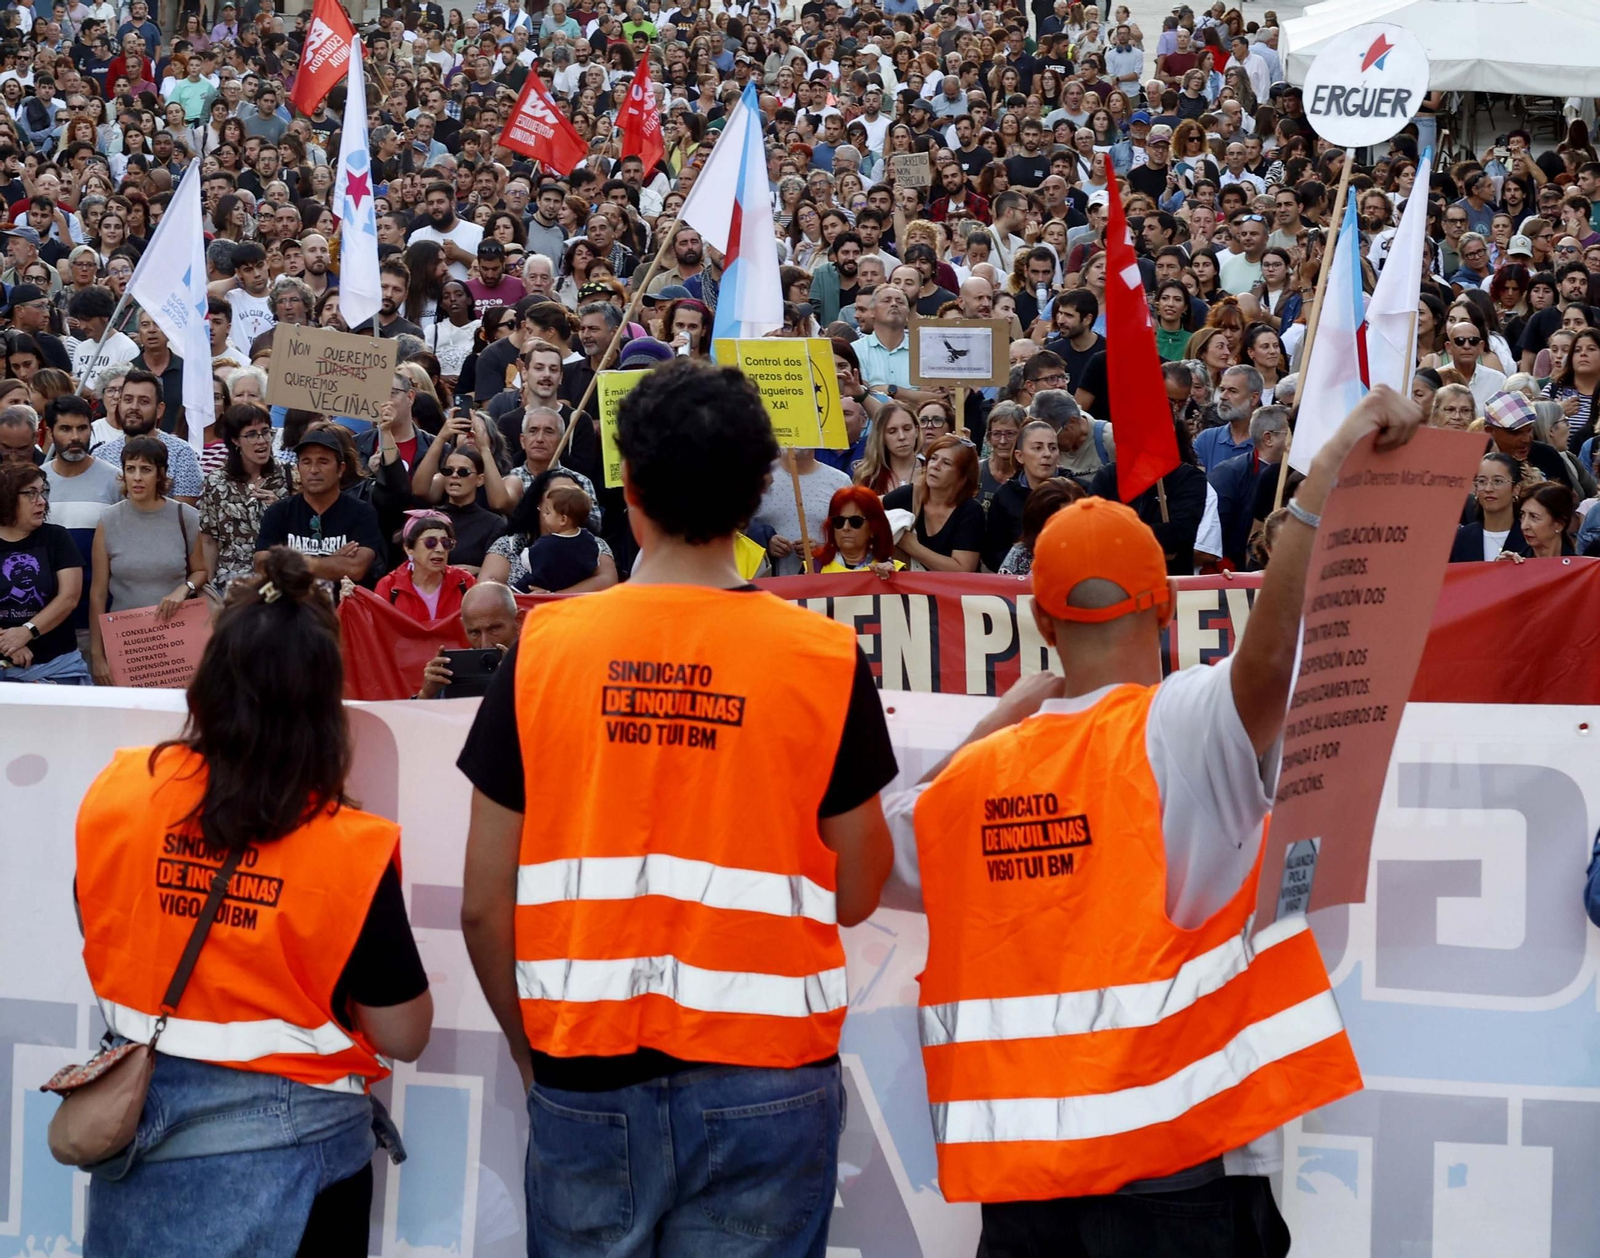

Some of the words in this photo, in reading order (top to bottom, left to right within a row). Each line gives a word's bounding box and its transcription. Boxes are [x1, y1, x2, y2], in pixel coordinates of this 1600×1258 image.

[1310, 85, 1412, 118] ERGUER
[288, 339, 311, 358] NON
[324, 347, 387, 369] QUEREMOS
[745, 356, 781, 366] Control
[783, 357, 802, 367] dos
[316, 360, 367, 380] TURISTAS
[784, 371, 803, 381] dos
[284, 372, 338, 392] QUEREMOS
[309, 389, 379, 418] VECIÑAS
[771, 400, 789, 409] XA!
[1384, 526, 1408, 543] DOS
[1363, 587, 1386, 604] DOS
[121, 622, 170, 638] CONXELACIÓN
[171, 620, 186, 630] DOS
[123, 633, 167, 646] ALUGUEIROS.
[125, 641, 169, 655] RENOVACIÓN
[171, 639, 185, 648] DOS
[126, 652, 168, 664] CONTRATOS.
[128, 660, 170, 674] SUSPENSIÓN
[171, 657, 186, 666] DOS
[1346, 648, 1368, 667] DOS
[608, 660, 712, 687] SINDICATO
[144, 680, 159, 688] DOS
[605, 688, 631, 712] DE
[635, 690, 741, 722] INQUILINAS
[1372, 705, 1389, 722] DE
[606, 721, 652, 744] VIGO
[656, 724, 685, 746] TUI
[687, 726, 717, 750] BM
[1314, 745, 1320, 761] E
[1321, 741, 1341, 759] POR
[985, 829, 998, 851] DE
[1000, 819, 1087, 851] INQUILINAS
[159, 862, 184, 886] DE
[986, 859, 1015, 882] VIGO
[1015, 856, 1044, 880] TUI
[1047, 853, 1074, 877] BM
[159, 892, 200, 919] VIGO
[231, 905, 258, 930] BM
